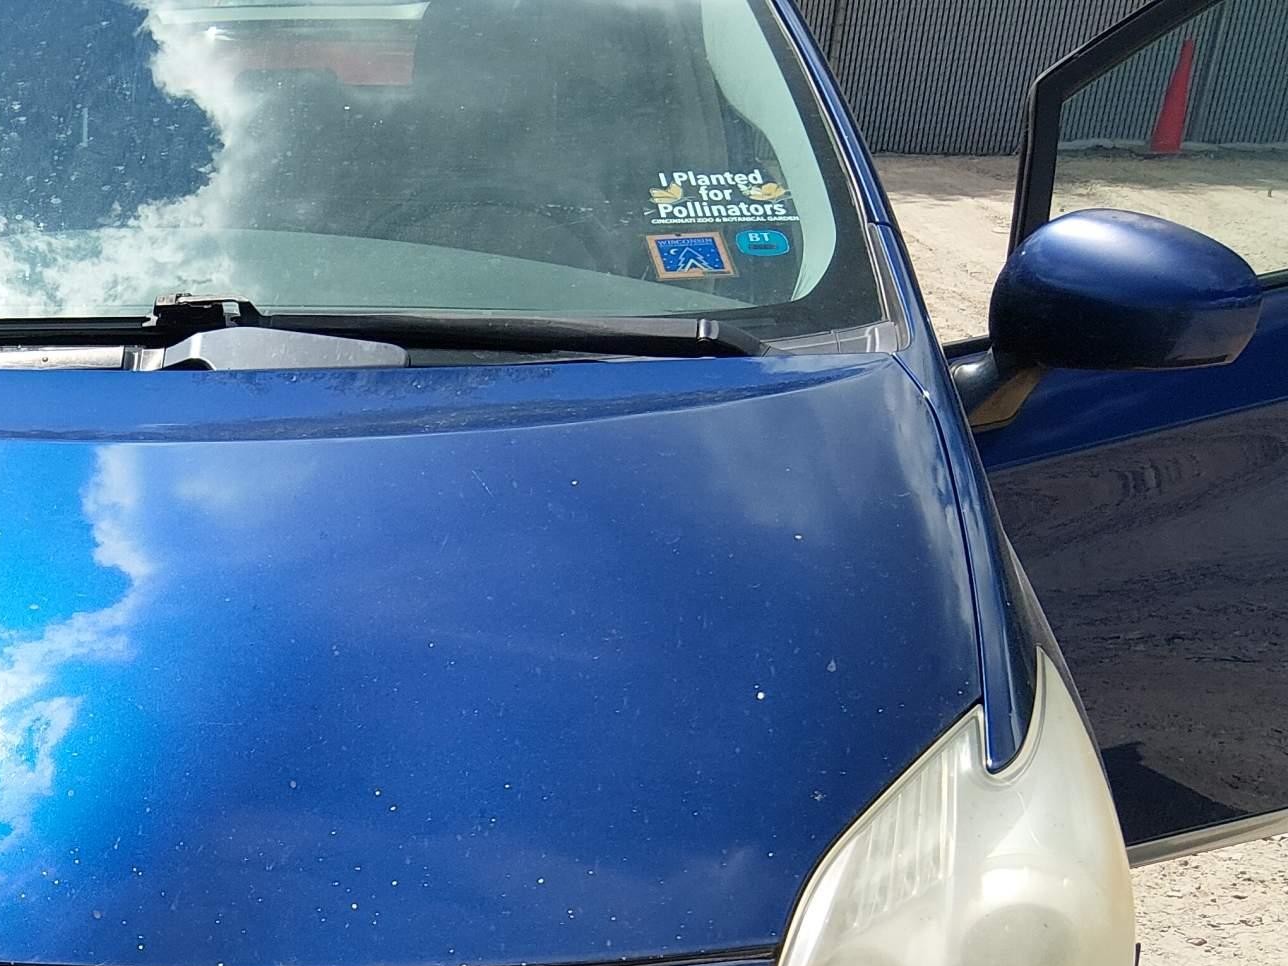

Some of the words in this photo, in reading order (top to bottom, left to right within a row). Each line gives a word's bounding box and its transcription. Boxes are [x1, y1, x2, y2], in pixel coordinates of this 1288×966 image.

[658, 172, 668, 187] I
[673, 169, 763, 187] Planted
[698, 185, 732, 201] for
[657, 201, 786, 218] Pollinators
[748, 232, 770, 242] BT
